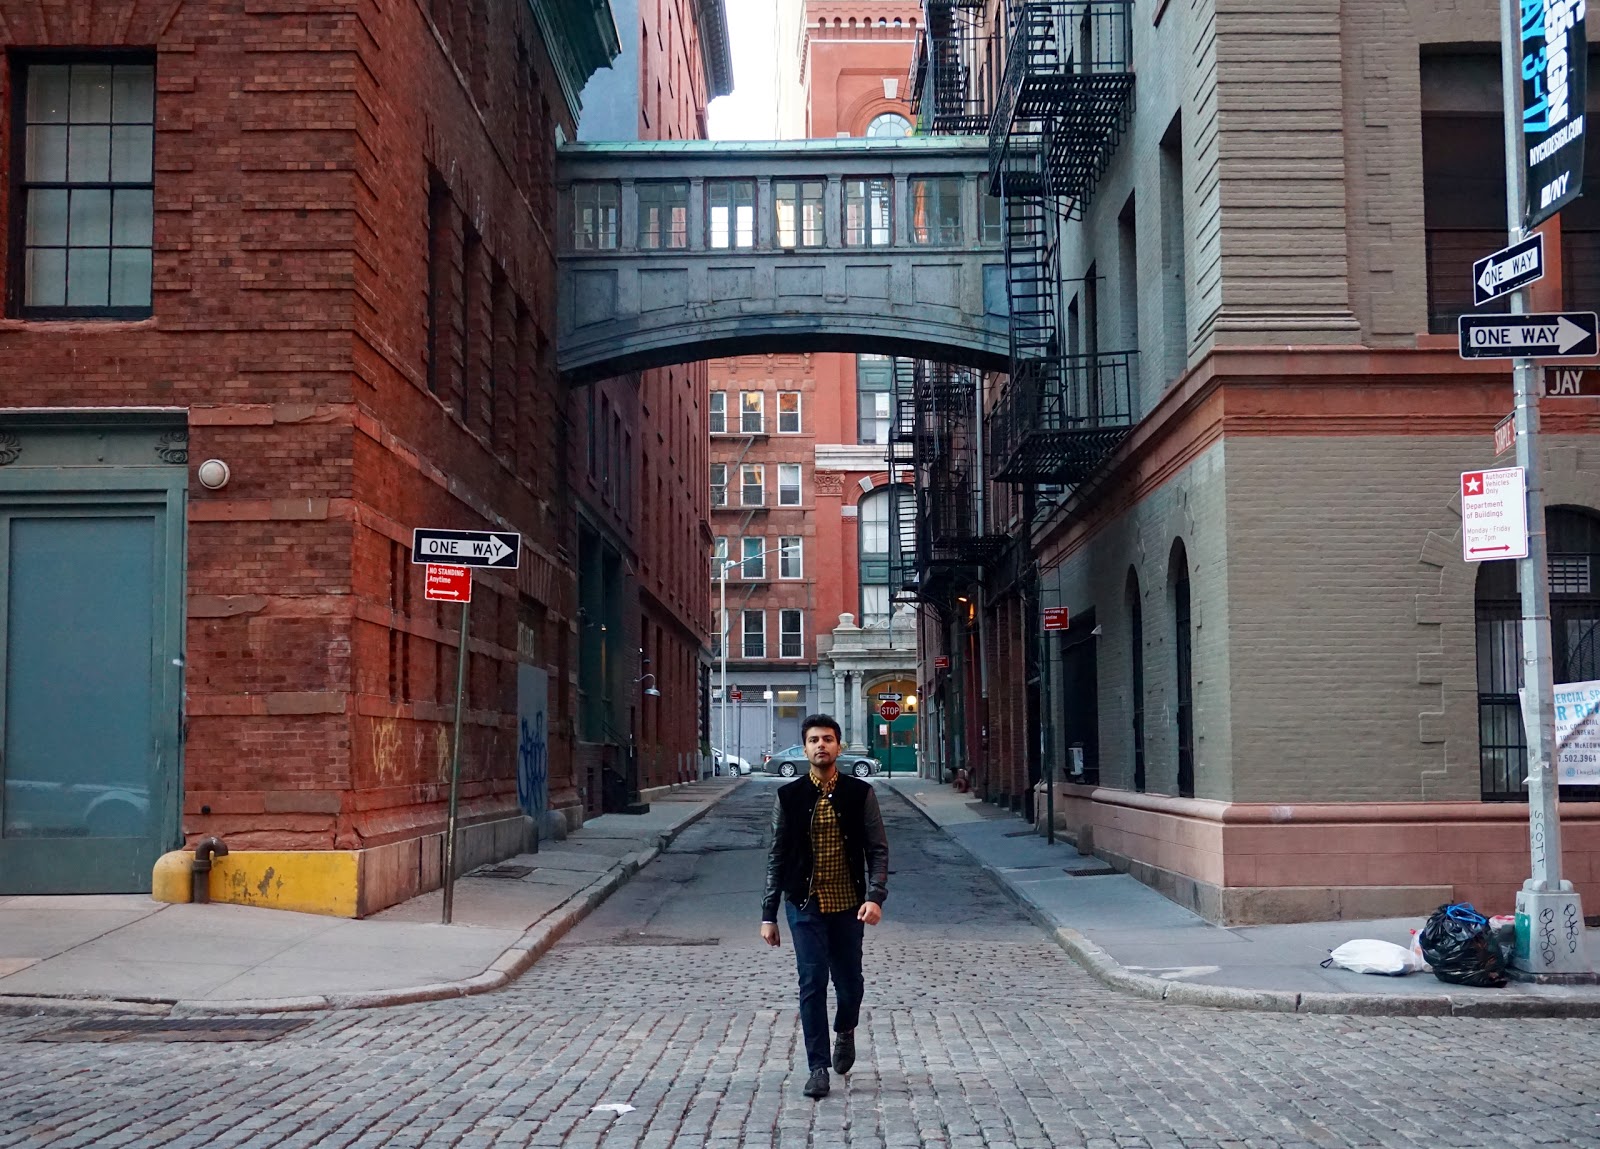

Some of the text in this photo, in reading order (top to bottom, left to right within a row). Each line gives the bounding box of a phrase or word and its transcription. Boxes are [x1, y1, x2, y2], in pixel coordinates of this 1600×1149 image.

[1484, 265, 1504, 287] ONE
[1512, 251, 1533, 275] WAY
[1475, 327, 1560, 345] ONE WAY
[1549, 370, 1583, 395] JAY
[1485, 471, 1518, 480] Authorized
[1466, 500, 1504, 510] Department
[1474, 510, 1504, 518] Buildings
[429, 540, 503, 556] ONE WAY
[438, 568, 464, 577] STANDING
[429, 575, 452, 584] Anytime
[1554, 691, 1587, 704] ERCIAL
[882, 706, 900, 714] STOP
[1534, 810, 1545, 869] SCOTT
